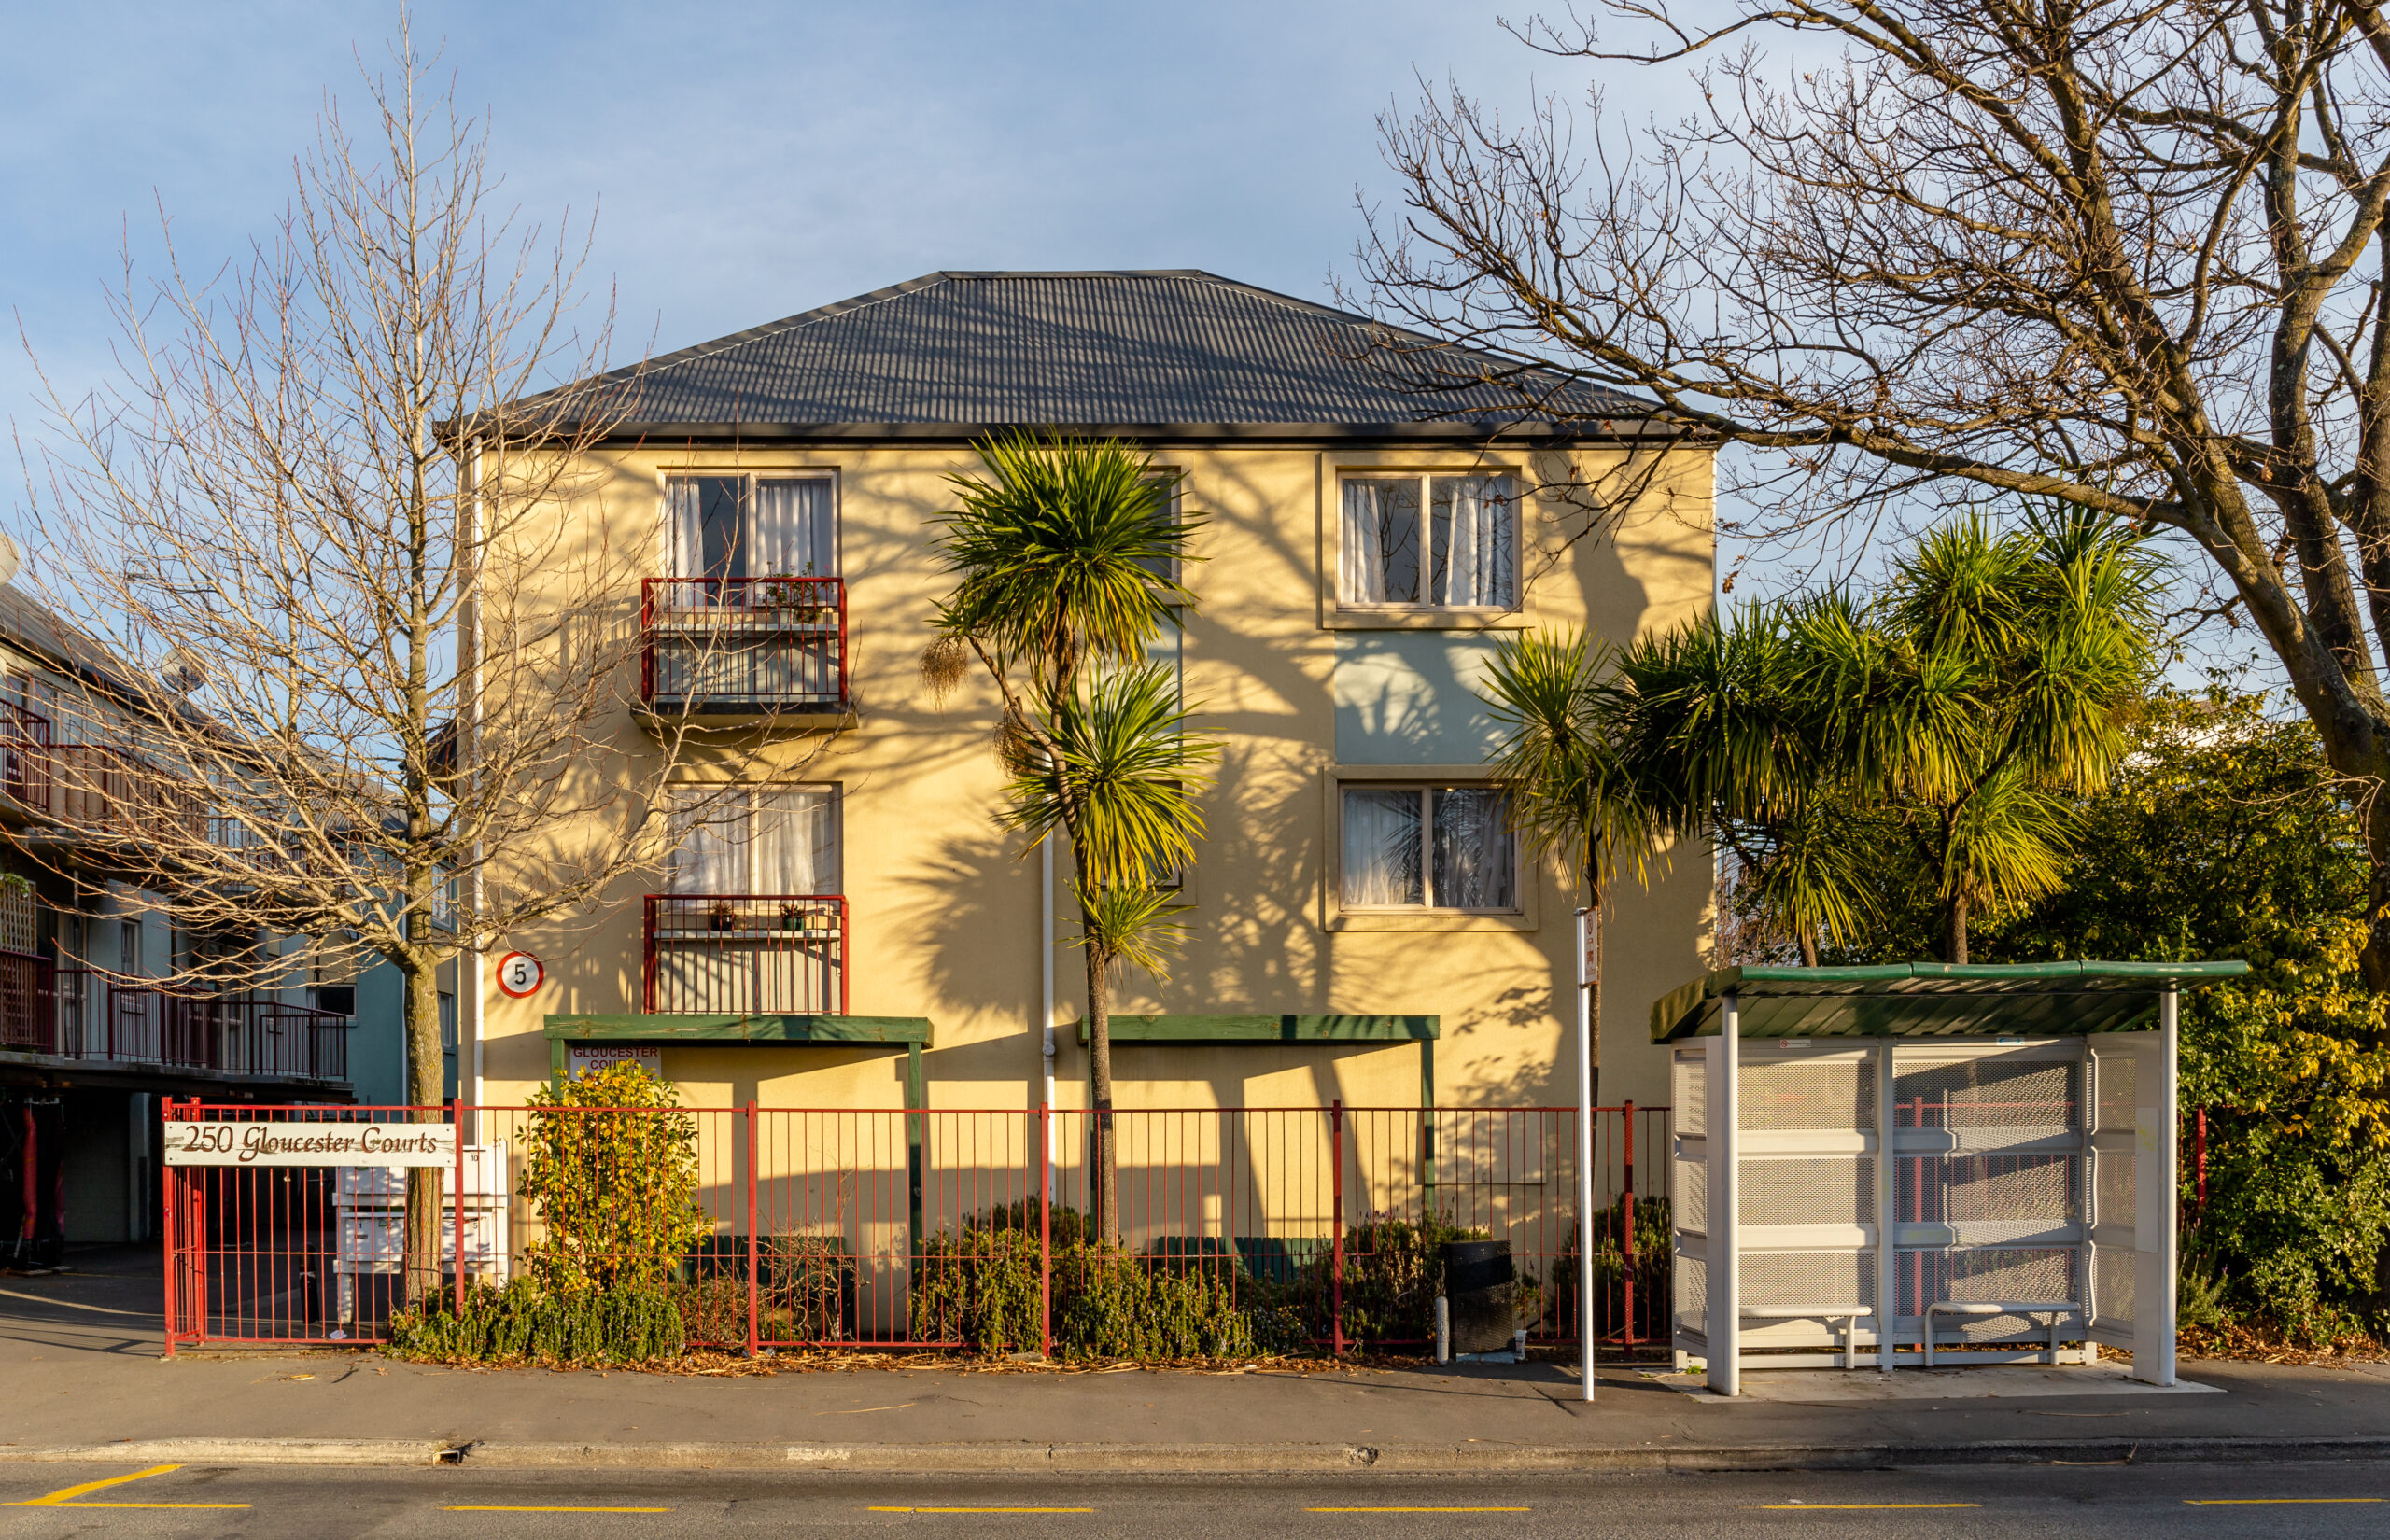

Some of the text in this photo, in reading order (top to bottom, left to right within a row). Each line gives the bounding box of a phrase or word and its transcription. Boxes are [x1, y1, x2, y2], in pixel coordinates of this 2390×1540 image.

[514, 963, 527, 985] 5
[573, 1046, 658, 1057] GLOUCESTER
[182, 1126, 437, 1162] 250 Gloucester Courts
